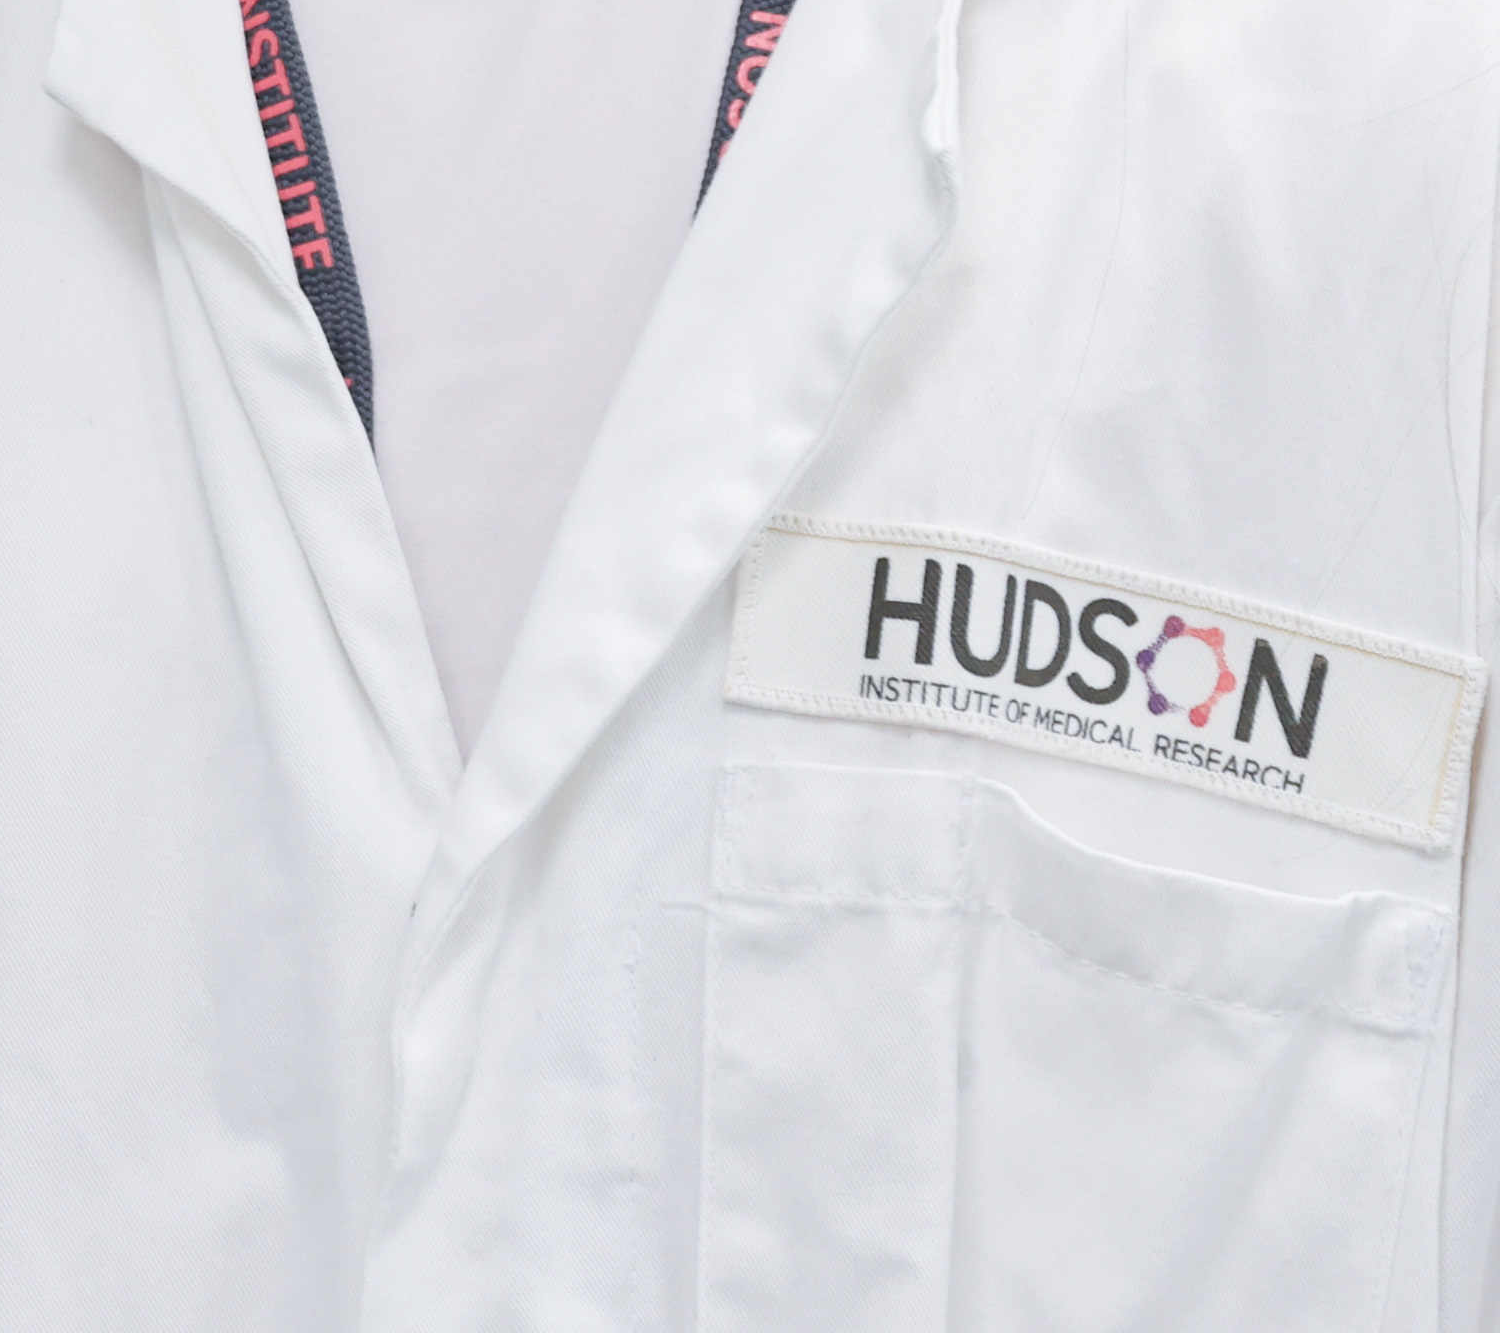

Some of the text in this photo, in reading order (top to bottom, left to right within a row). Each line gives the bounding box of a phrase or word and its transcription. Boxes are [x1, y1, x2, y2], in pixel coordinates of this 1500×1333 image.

[859, 674, 1305, 794] INSTITUTE OF MEDICAL RESEARCH
[864, 557, 1328, 759] HUDSON
